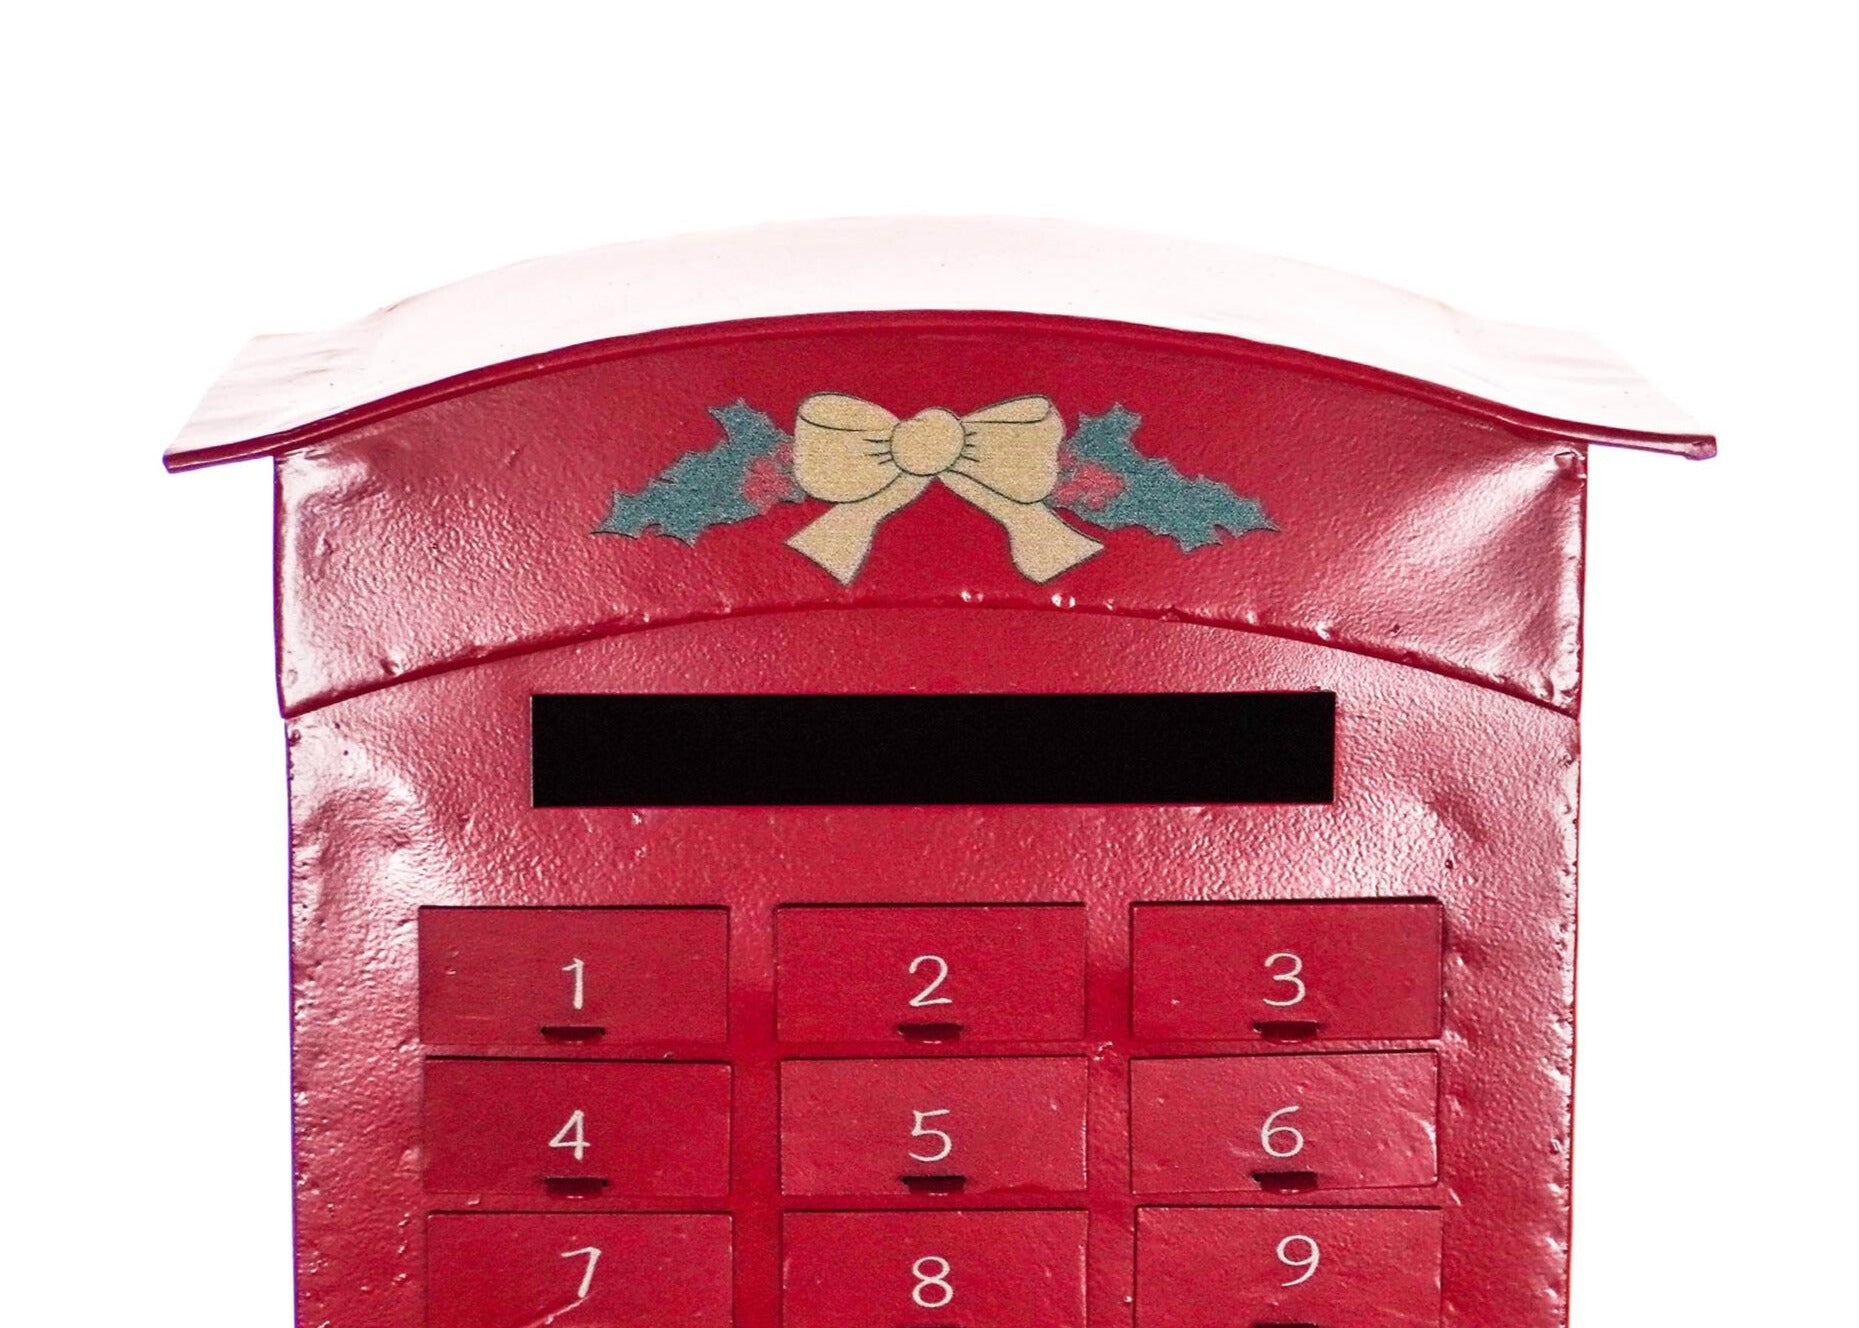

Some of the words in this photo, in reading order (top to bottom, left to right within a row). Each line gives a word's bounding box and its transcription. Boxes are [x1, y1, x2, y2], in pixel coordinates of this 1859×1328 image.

[562, 957, 585, 1010] 1
[908, 955, 953, 1007] 2
[1263, 952, 1306, 1007] 3
[548, 1109, 591, 1161] 4
[908, 1108, 953, 1162] 5
[1259, 1105, 1305, 1158] 6
[561, 1246, 602, 1299] 7
[911, 1255, 954, 1308] 8
[1275, 1234, 1321, 1287] 9
